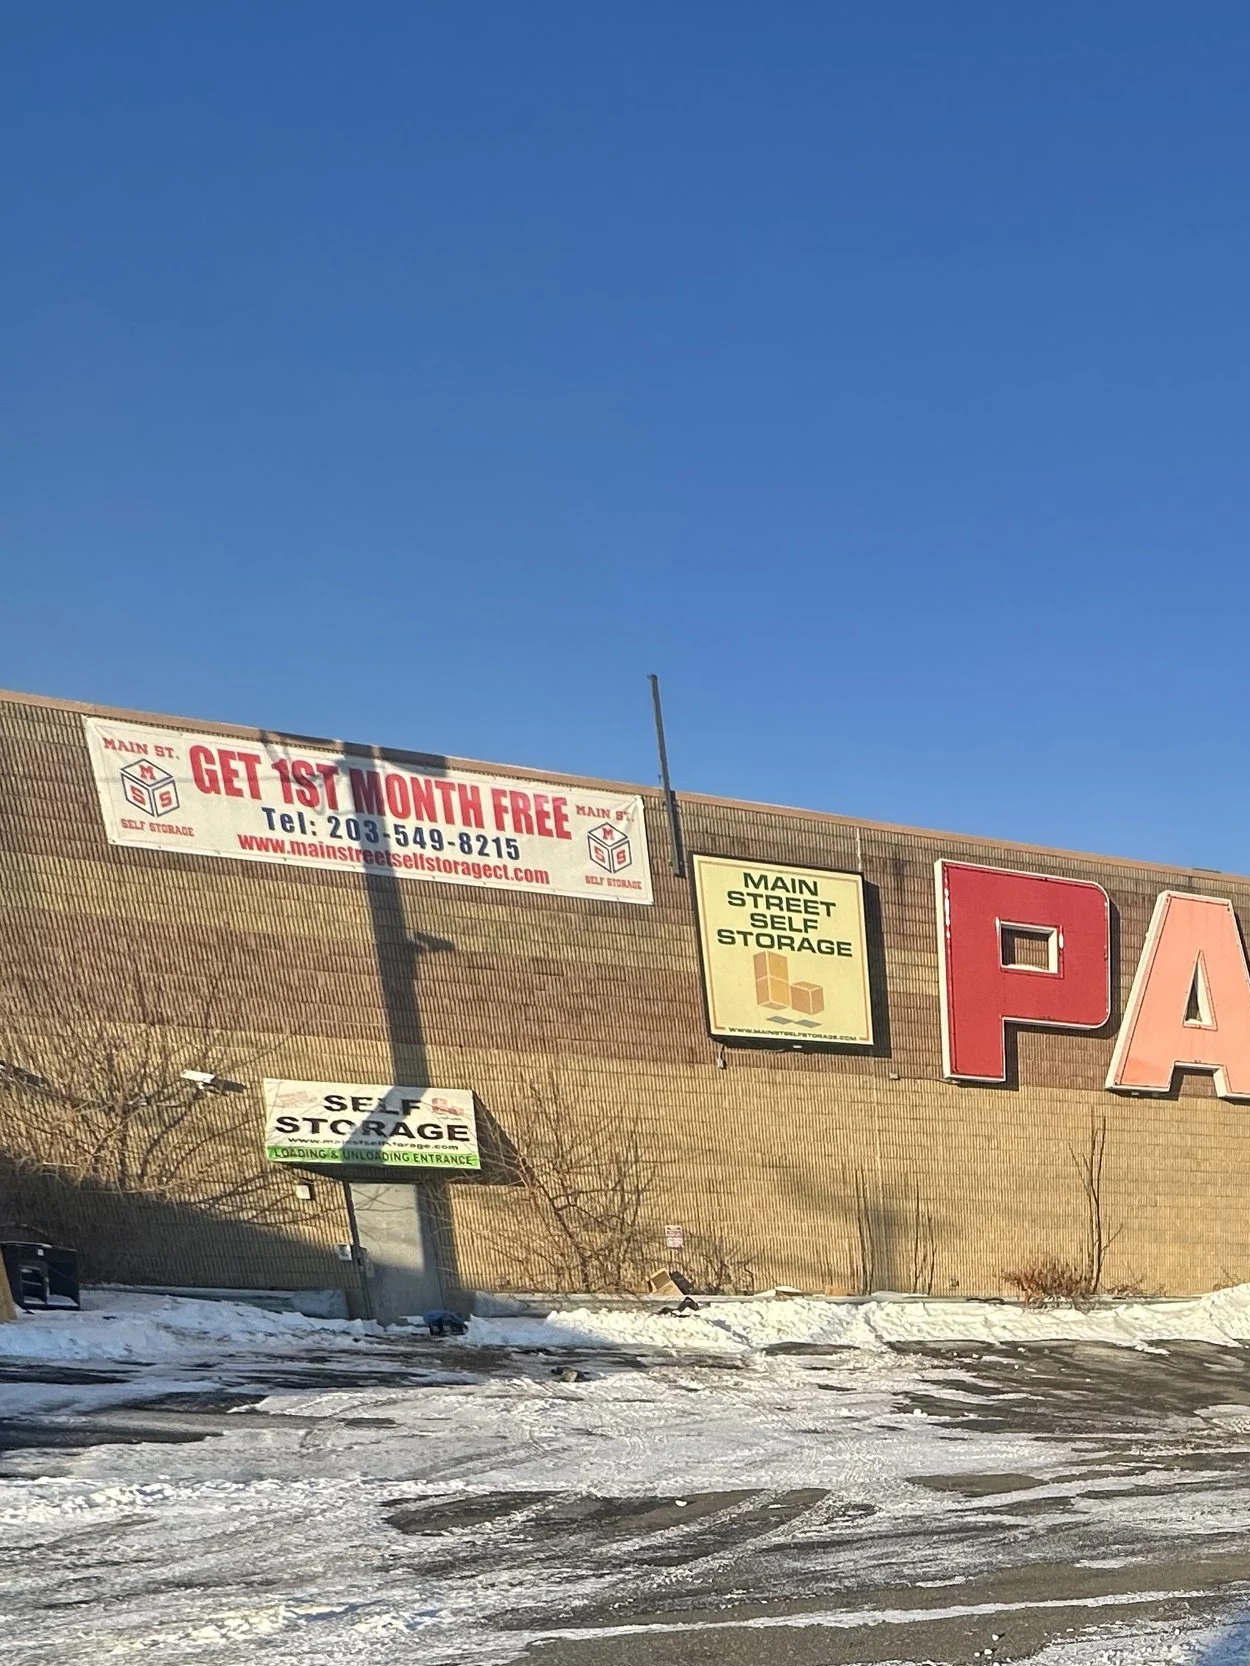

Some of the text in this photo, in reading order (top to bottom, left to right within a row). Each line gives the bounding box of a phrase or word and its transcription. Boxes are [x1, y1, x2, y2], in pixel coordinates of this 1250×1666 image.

[102, 737, 180, 760] MAIN ST.
[138, 763, 156, 780] M
[189, 744, 572, 840] GET 1ST MONTH FREE
[575, 804, 611, 819] MAIN
[121, 818, 195, 837] SELF STORAGE
[261, 807, 520, 860] Tel: 203-549-8215
[237, 833, 550, 885] www.mainstreetselfstoragect.com
[585, 875, 643, 890] SELF STORAGE
[742, 872, 819, 896] MAIN
[727, 890, 837, 918] STREET
[750, 912, 819, 934] SELF
[717, 928, 853, 958] STORAGE
[323, 1094, 421, 1116] SELF
[275, 1116, 470, 1143] STORAGE
[274, 1147, 472, 1165] LOADING & UNLOADING ENTRANCE
